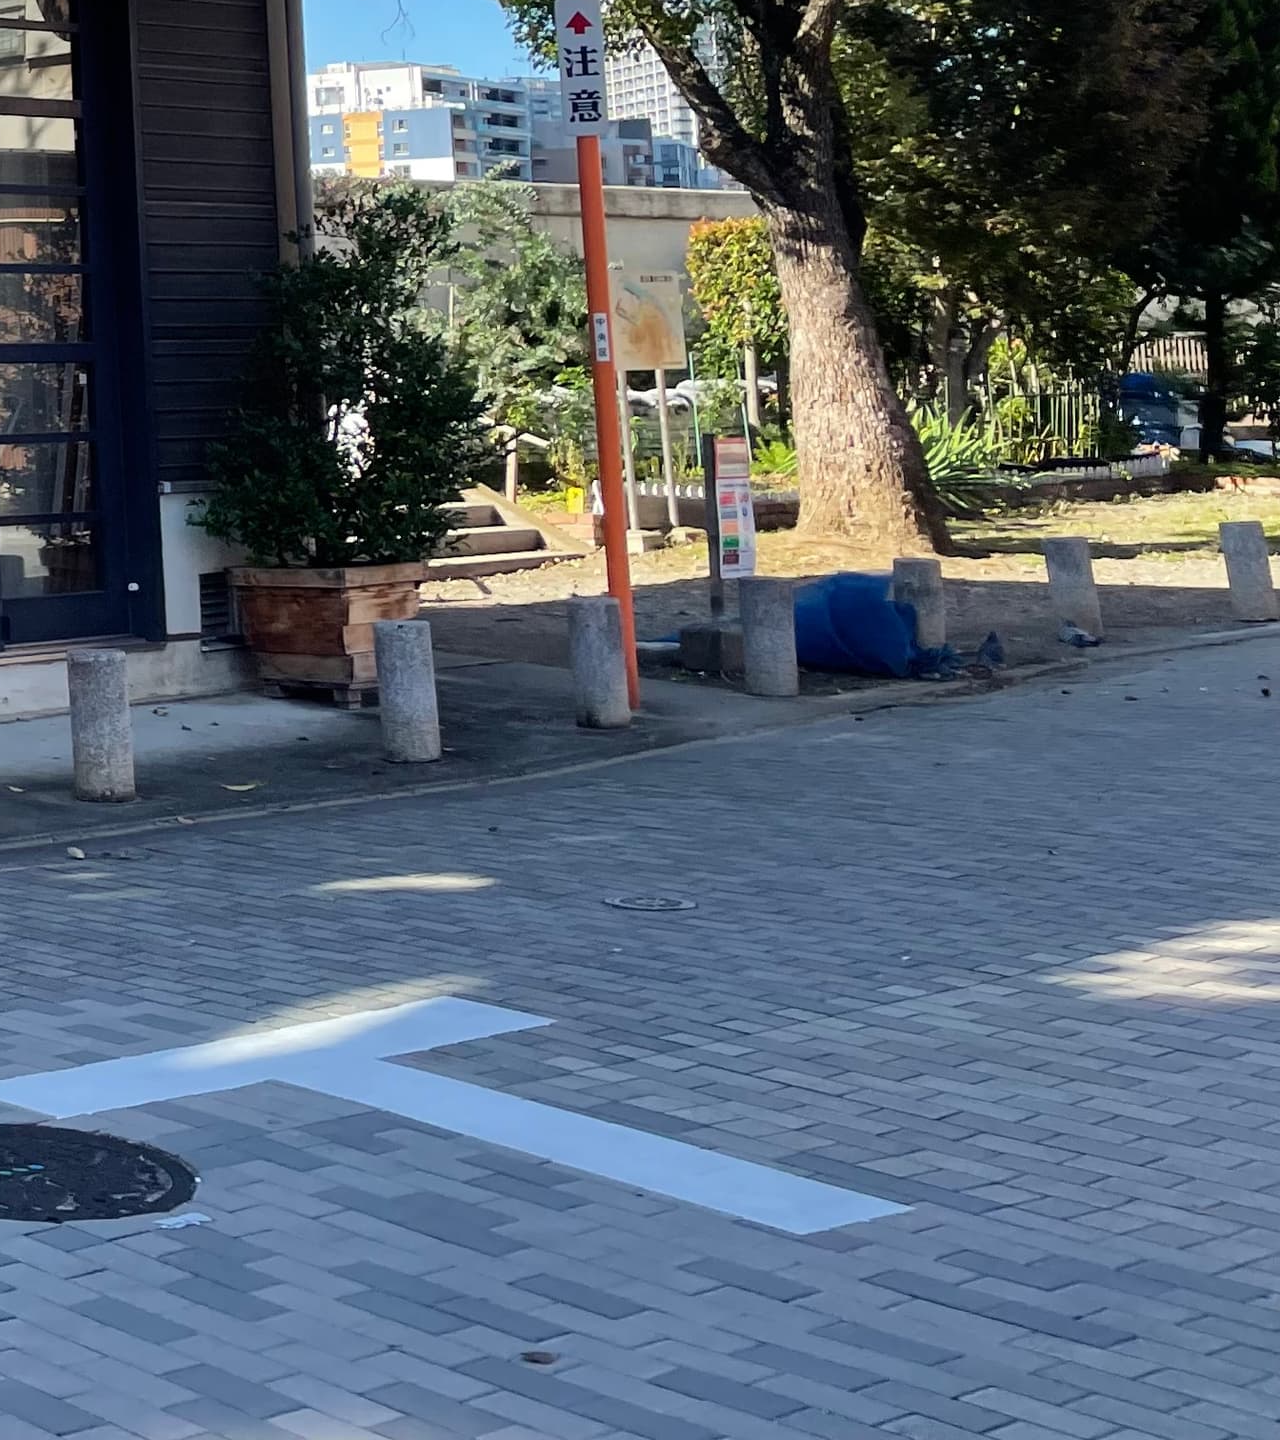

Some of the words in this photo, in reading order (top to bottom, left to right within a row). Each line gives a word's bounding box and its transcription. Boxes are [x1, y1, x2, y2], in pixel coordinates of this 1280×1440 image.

[563, 45, 602, 122] 注意
[595, 318, 608, 357] 中央区
